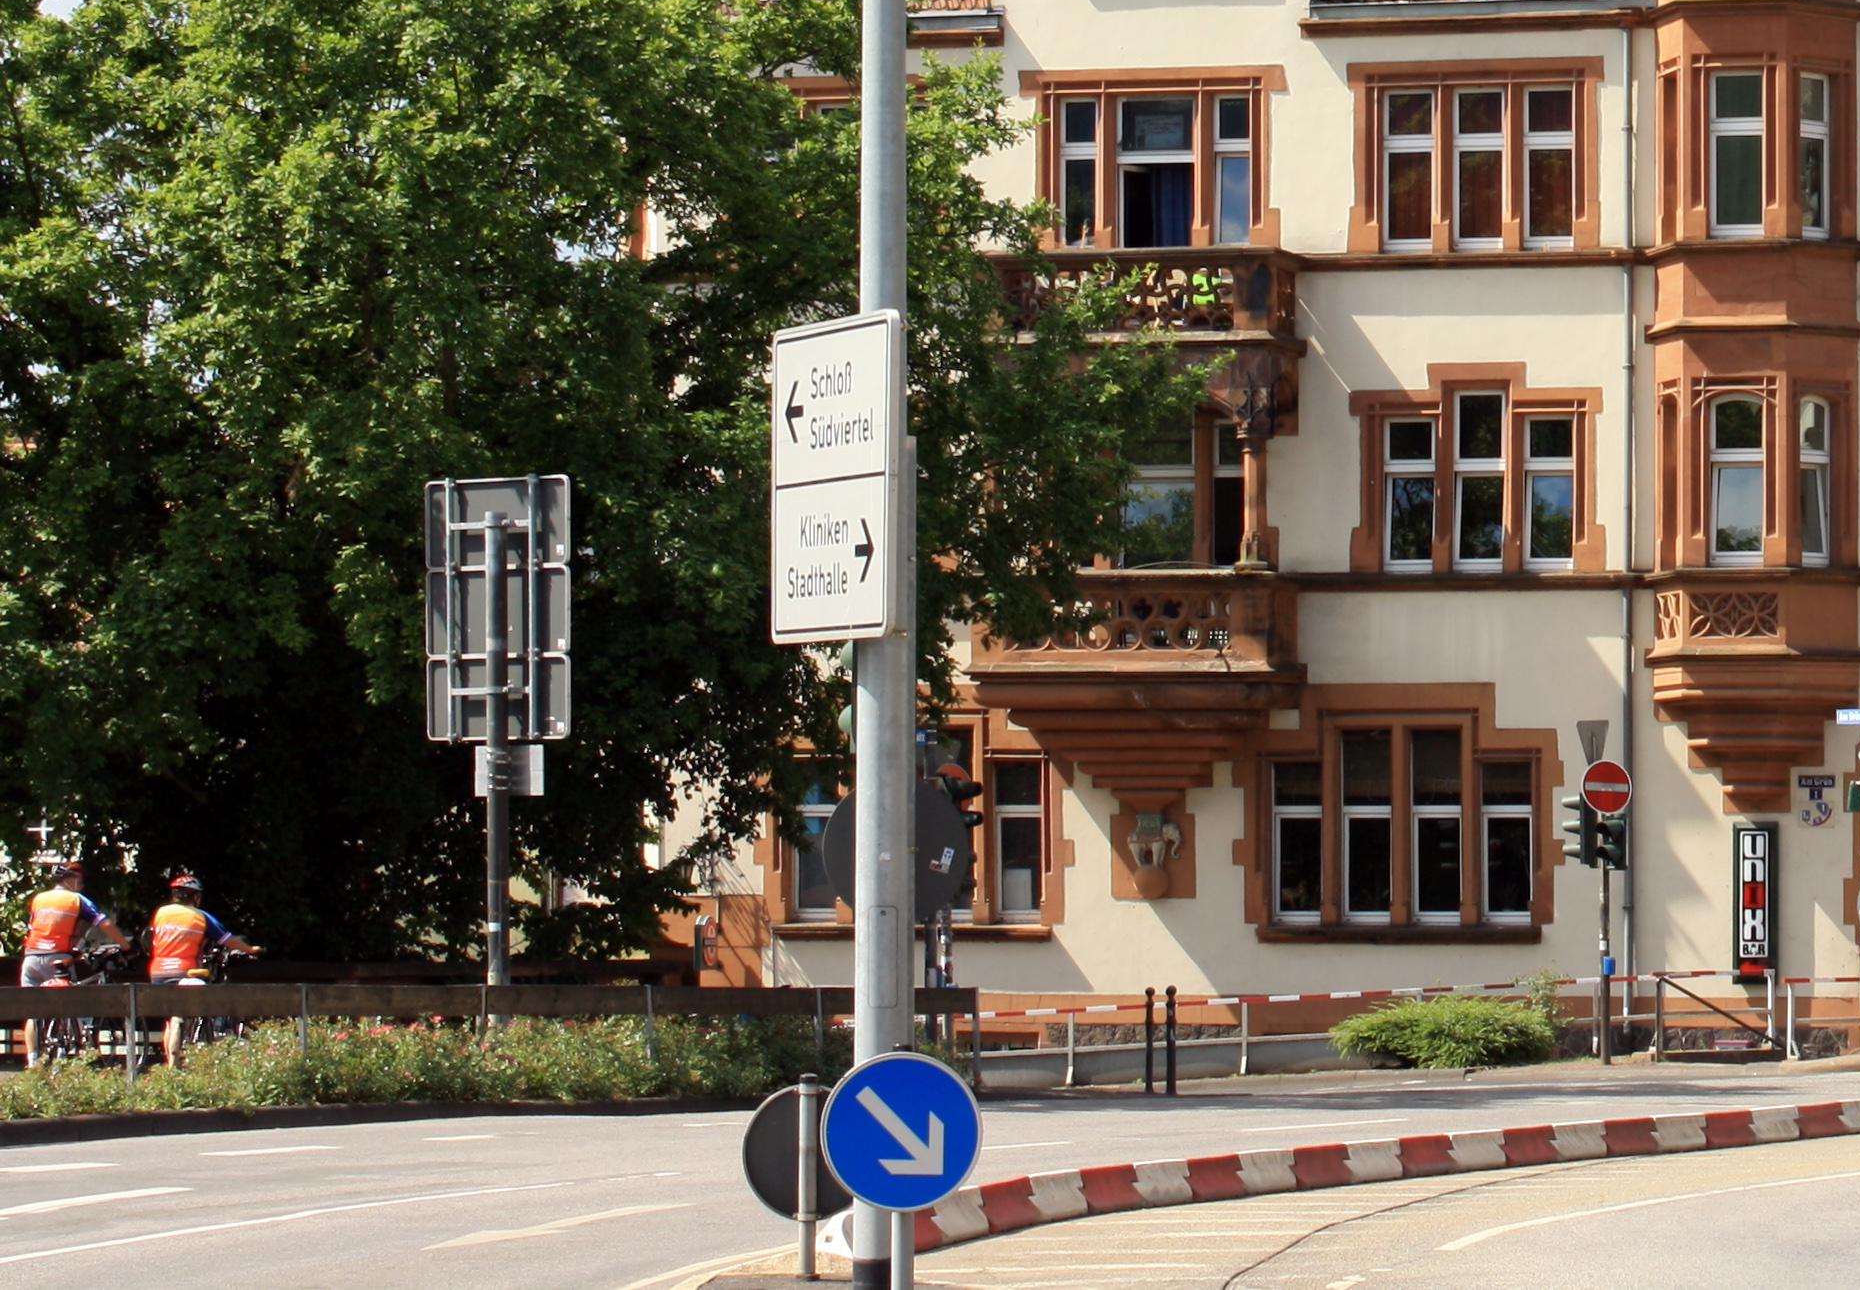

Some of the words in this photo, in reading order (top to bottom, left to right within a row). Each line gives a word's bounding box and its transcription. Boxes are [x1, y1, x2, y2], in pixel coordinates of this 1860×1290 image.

[810, 361, 852, 399] Schloß
[810, 408, 873, 449] Südviertel
[800, 513, 849, 548] Kliniken
[787, 562, 849, 599] Stadthalle
[1801, 777, 1813, 786] Am
